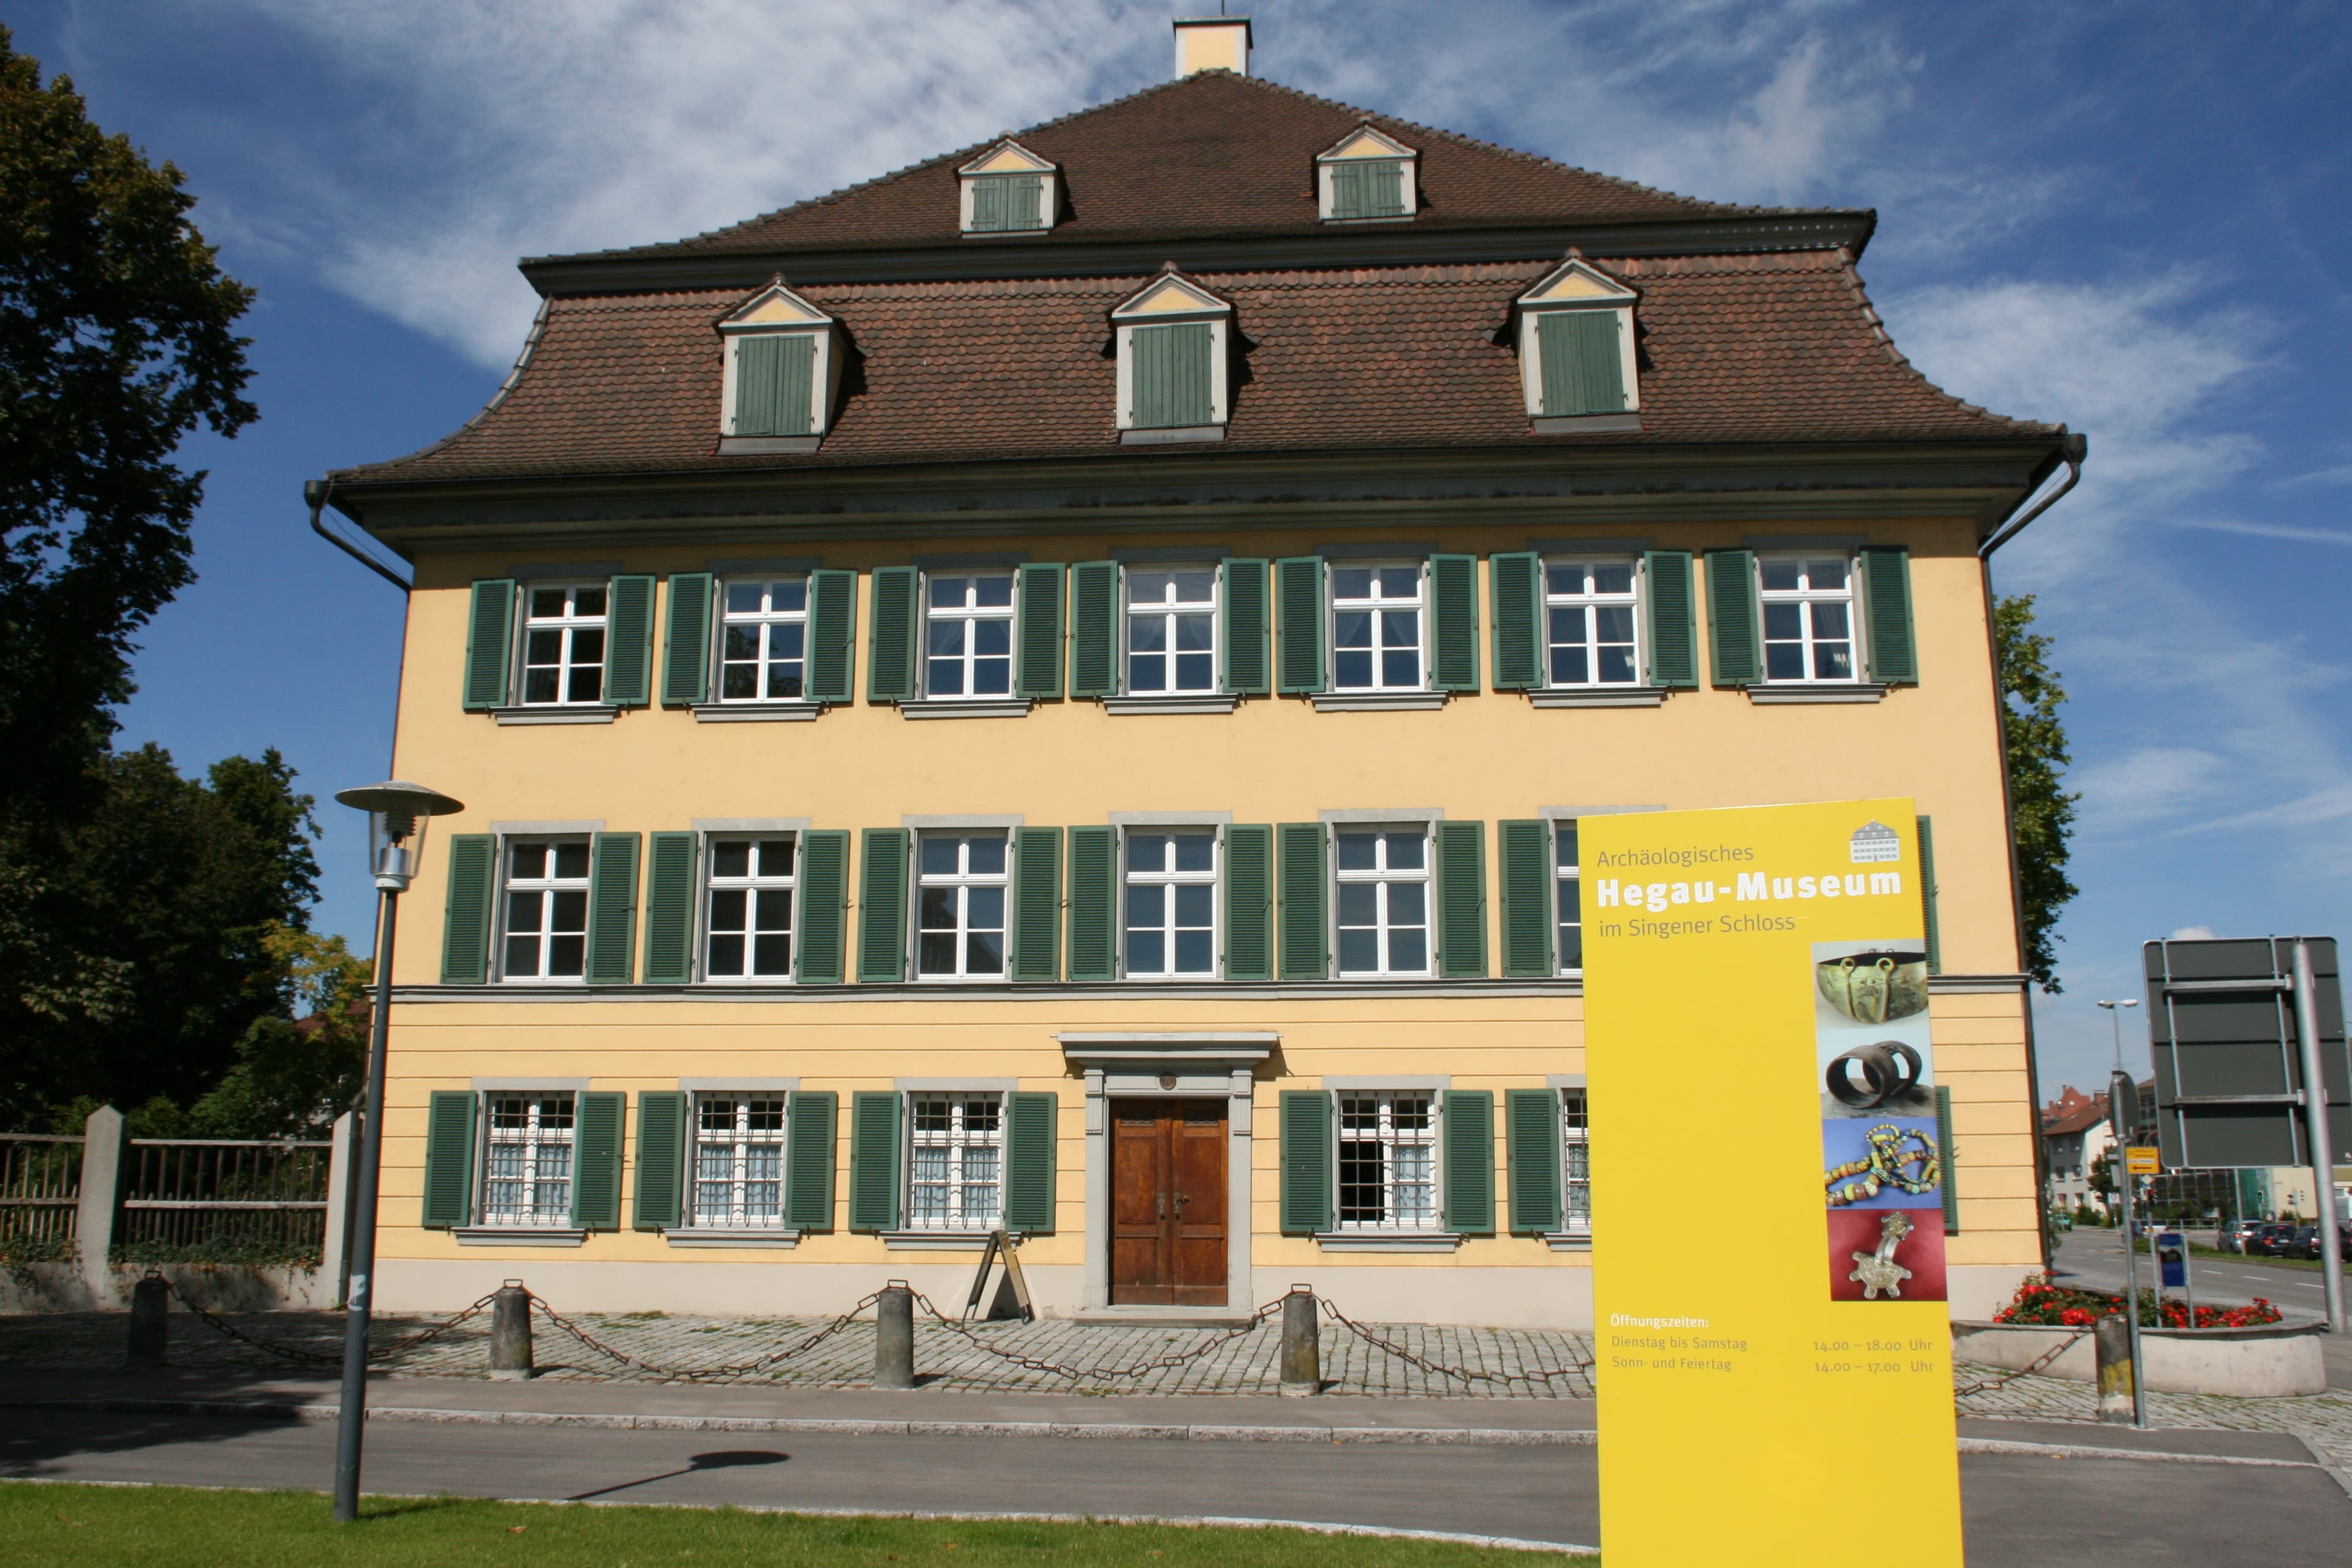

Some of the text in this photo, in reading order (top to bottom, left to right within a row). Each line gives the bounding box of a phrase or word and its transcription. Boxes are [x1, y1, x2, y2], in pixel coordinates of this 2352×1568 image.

[1597, 844, 1754, 867] Archäologisches
[1597, 871, 1901, 913] Hegau-Museum
[1600, 914, 1795, 939] im Singener Schloss
[1610, 1313, 1709, 1329] Öffnungszeiten:
[1611, 1335, 1747, 1352] Dienstag bis Samstag
[1814, 1341, 1849, 1352] 14.00
[1866, 1339, 1901, 1351] 18.00
[1909, 1339, 1933, 1351] Uhr
[1612, 1356, 1732, 1372] Sonn- und Feiertag
[1815, 1363, 1850, 1374] 14.00
[1868, 1363, 1901, 1374] 17.00
[1910, 1360, 1934, 1372] Uhr
